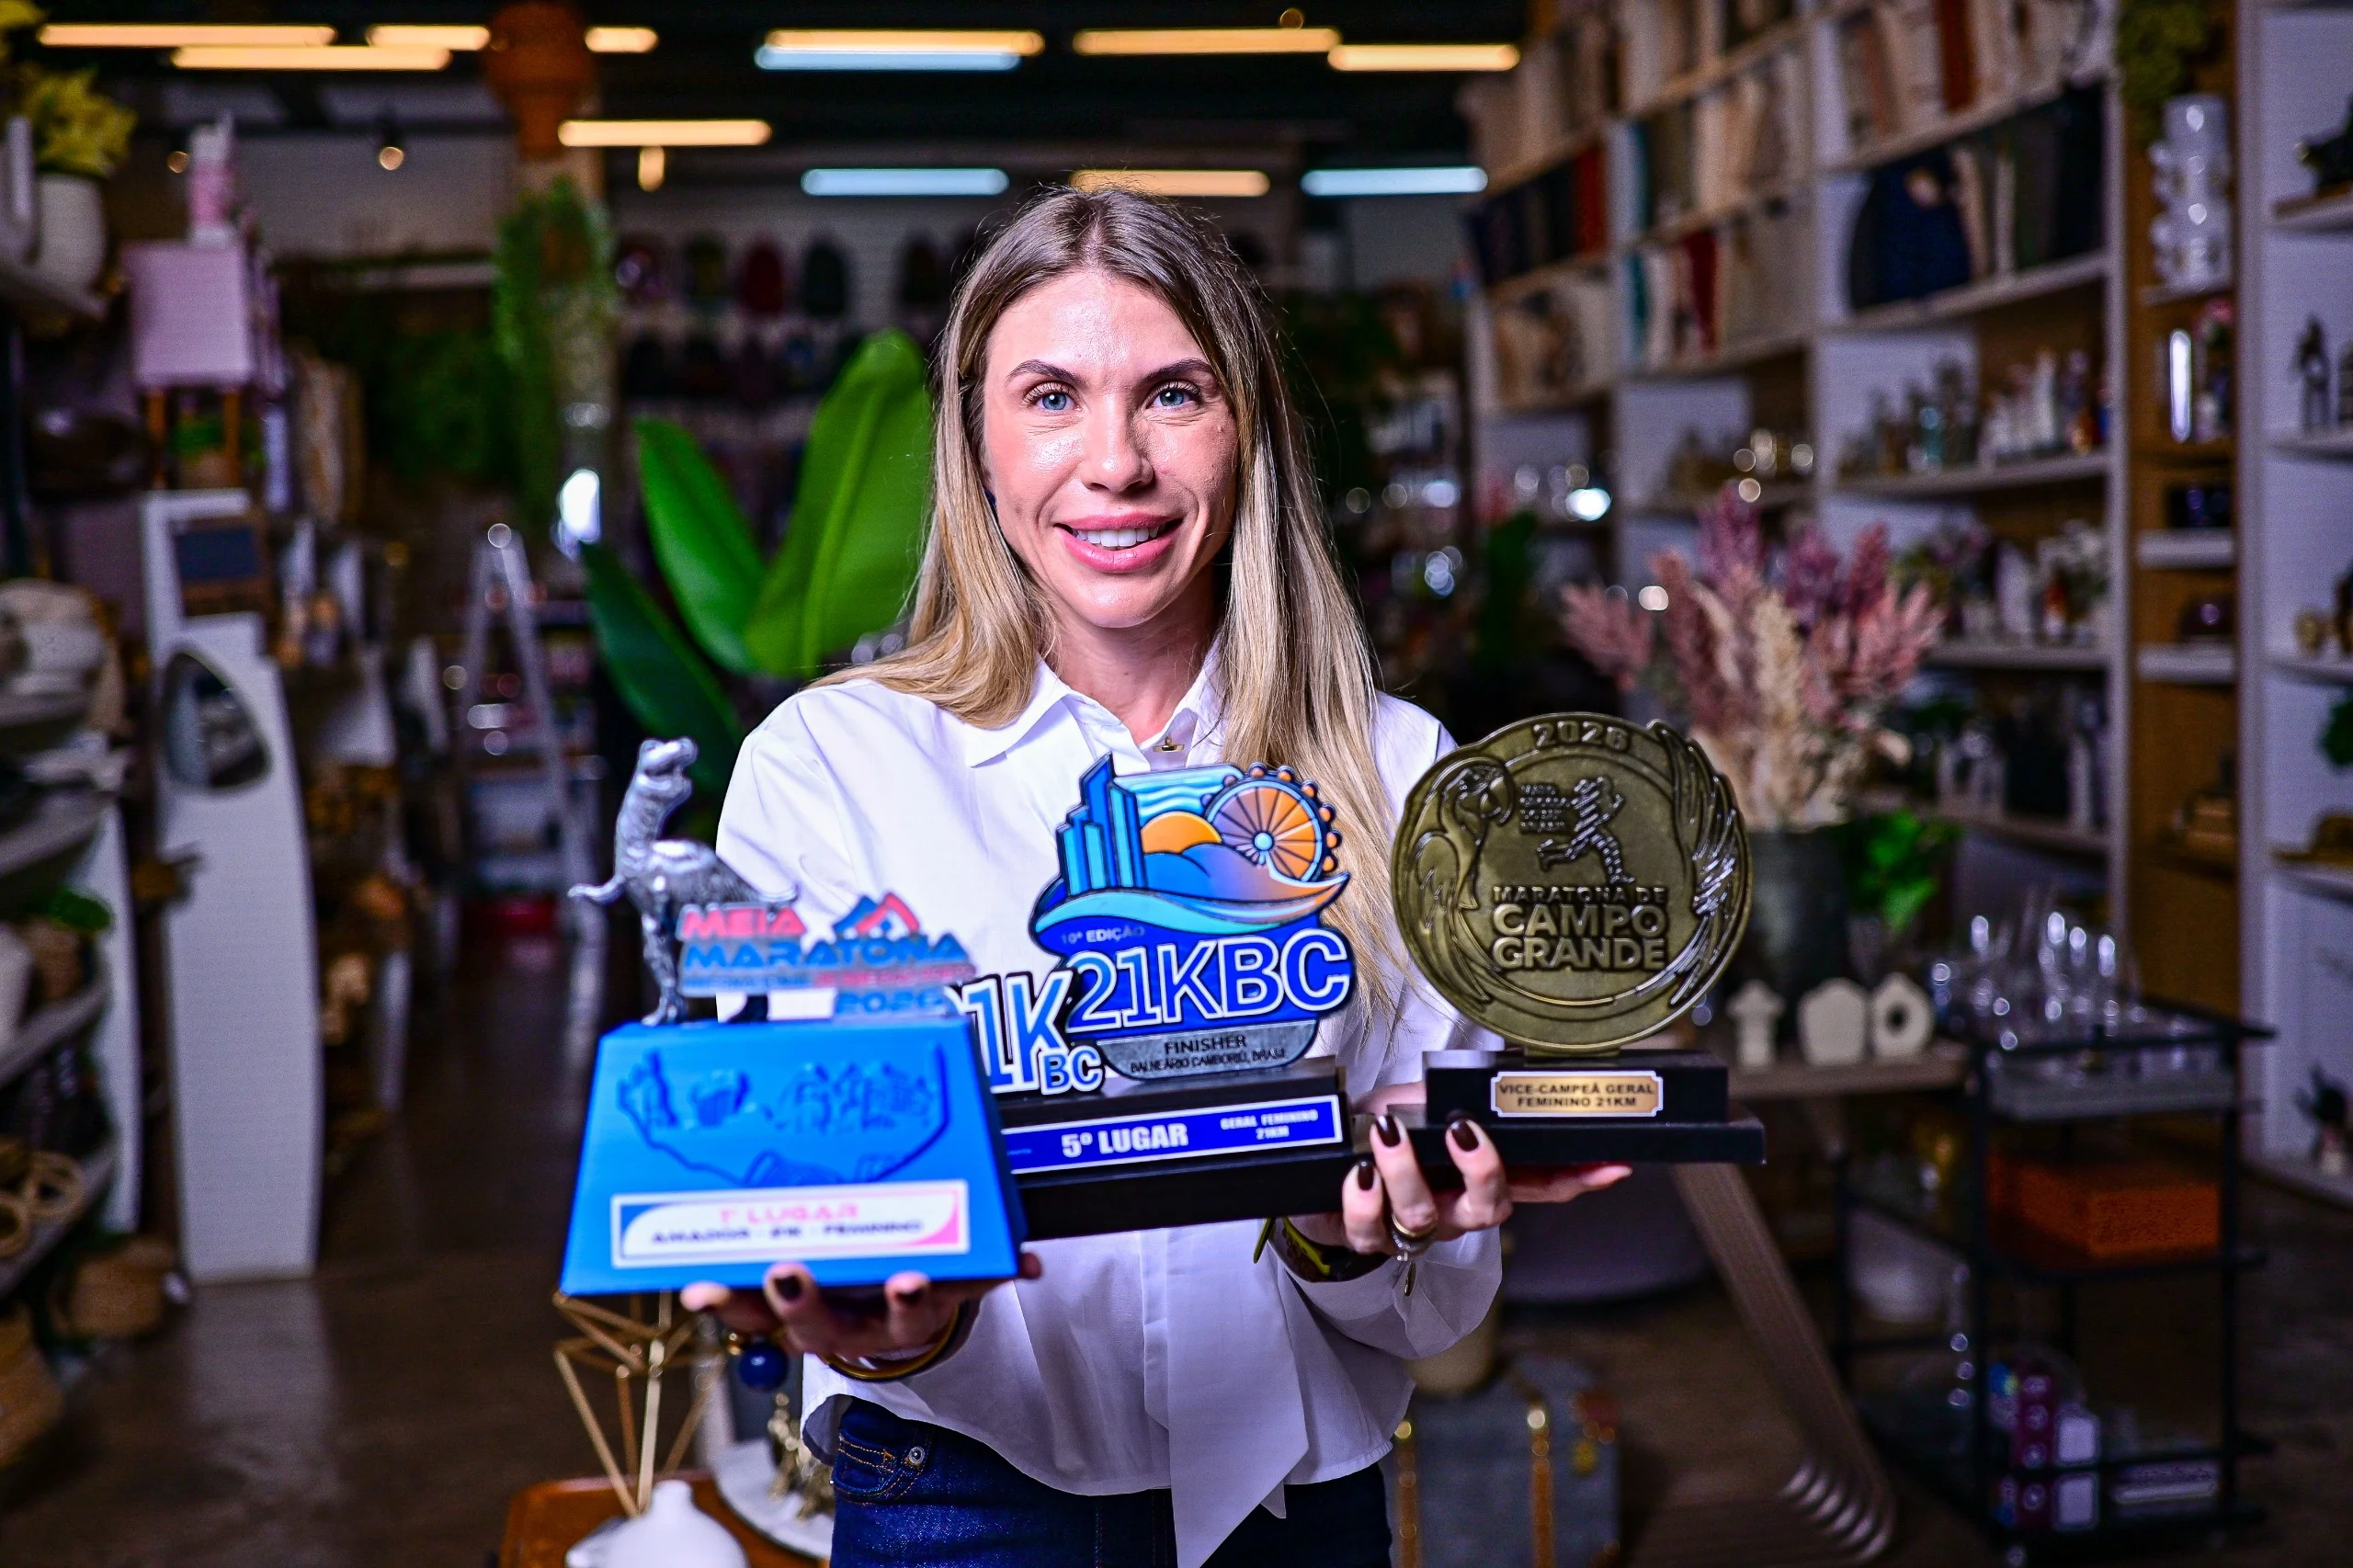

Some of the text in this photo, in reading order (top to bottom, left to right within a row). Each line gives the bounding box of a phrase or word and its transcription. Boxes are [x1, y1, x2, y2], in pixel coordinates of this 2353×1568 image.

[1493, 886, 1665, 902] MARATONA DE
[681, 906, 807, 937] MEIA
[1086, 925, 1145, 943] EDIÇÃO
[1493, 903, 1666, 937] CAMPO
[682, 932, 971, 967] MARATONA
[1493, 937, 1665, 968] GRANDE
[1066, 928, 1351, 1033] 21KBC
[1165, 1035, 1246, 1054] FINISHER
[1518, 1097, 1636, 1108] FEMININO 21KM
[1606, 1084, 1654, 1095] GERAL
[1097, 1123, 1188, 1154] LUGAR
